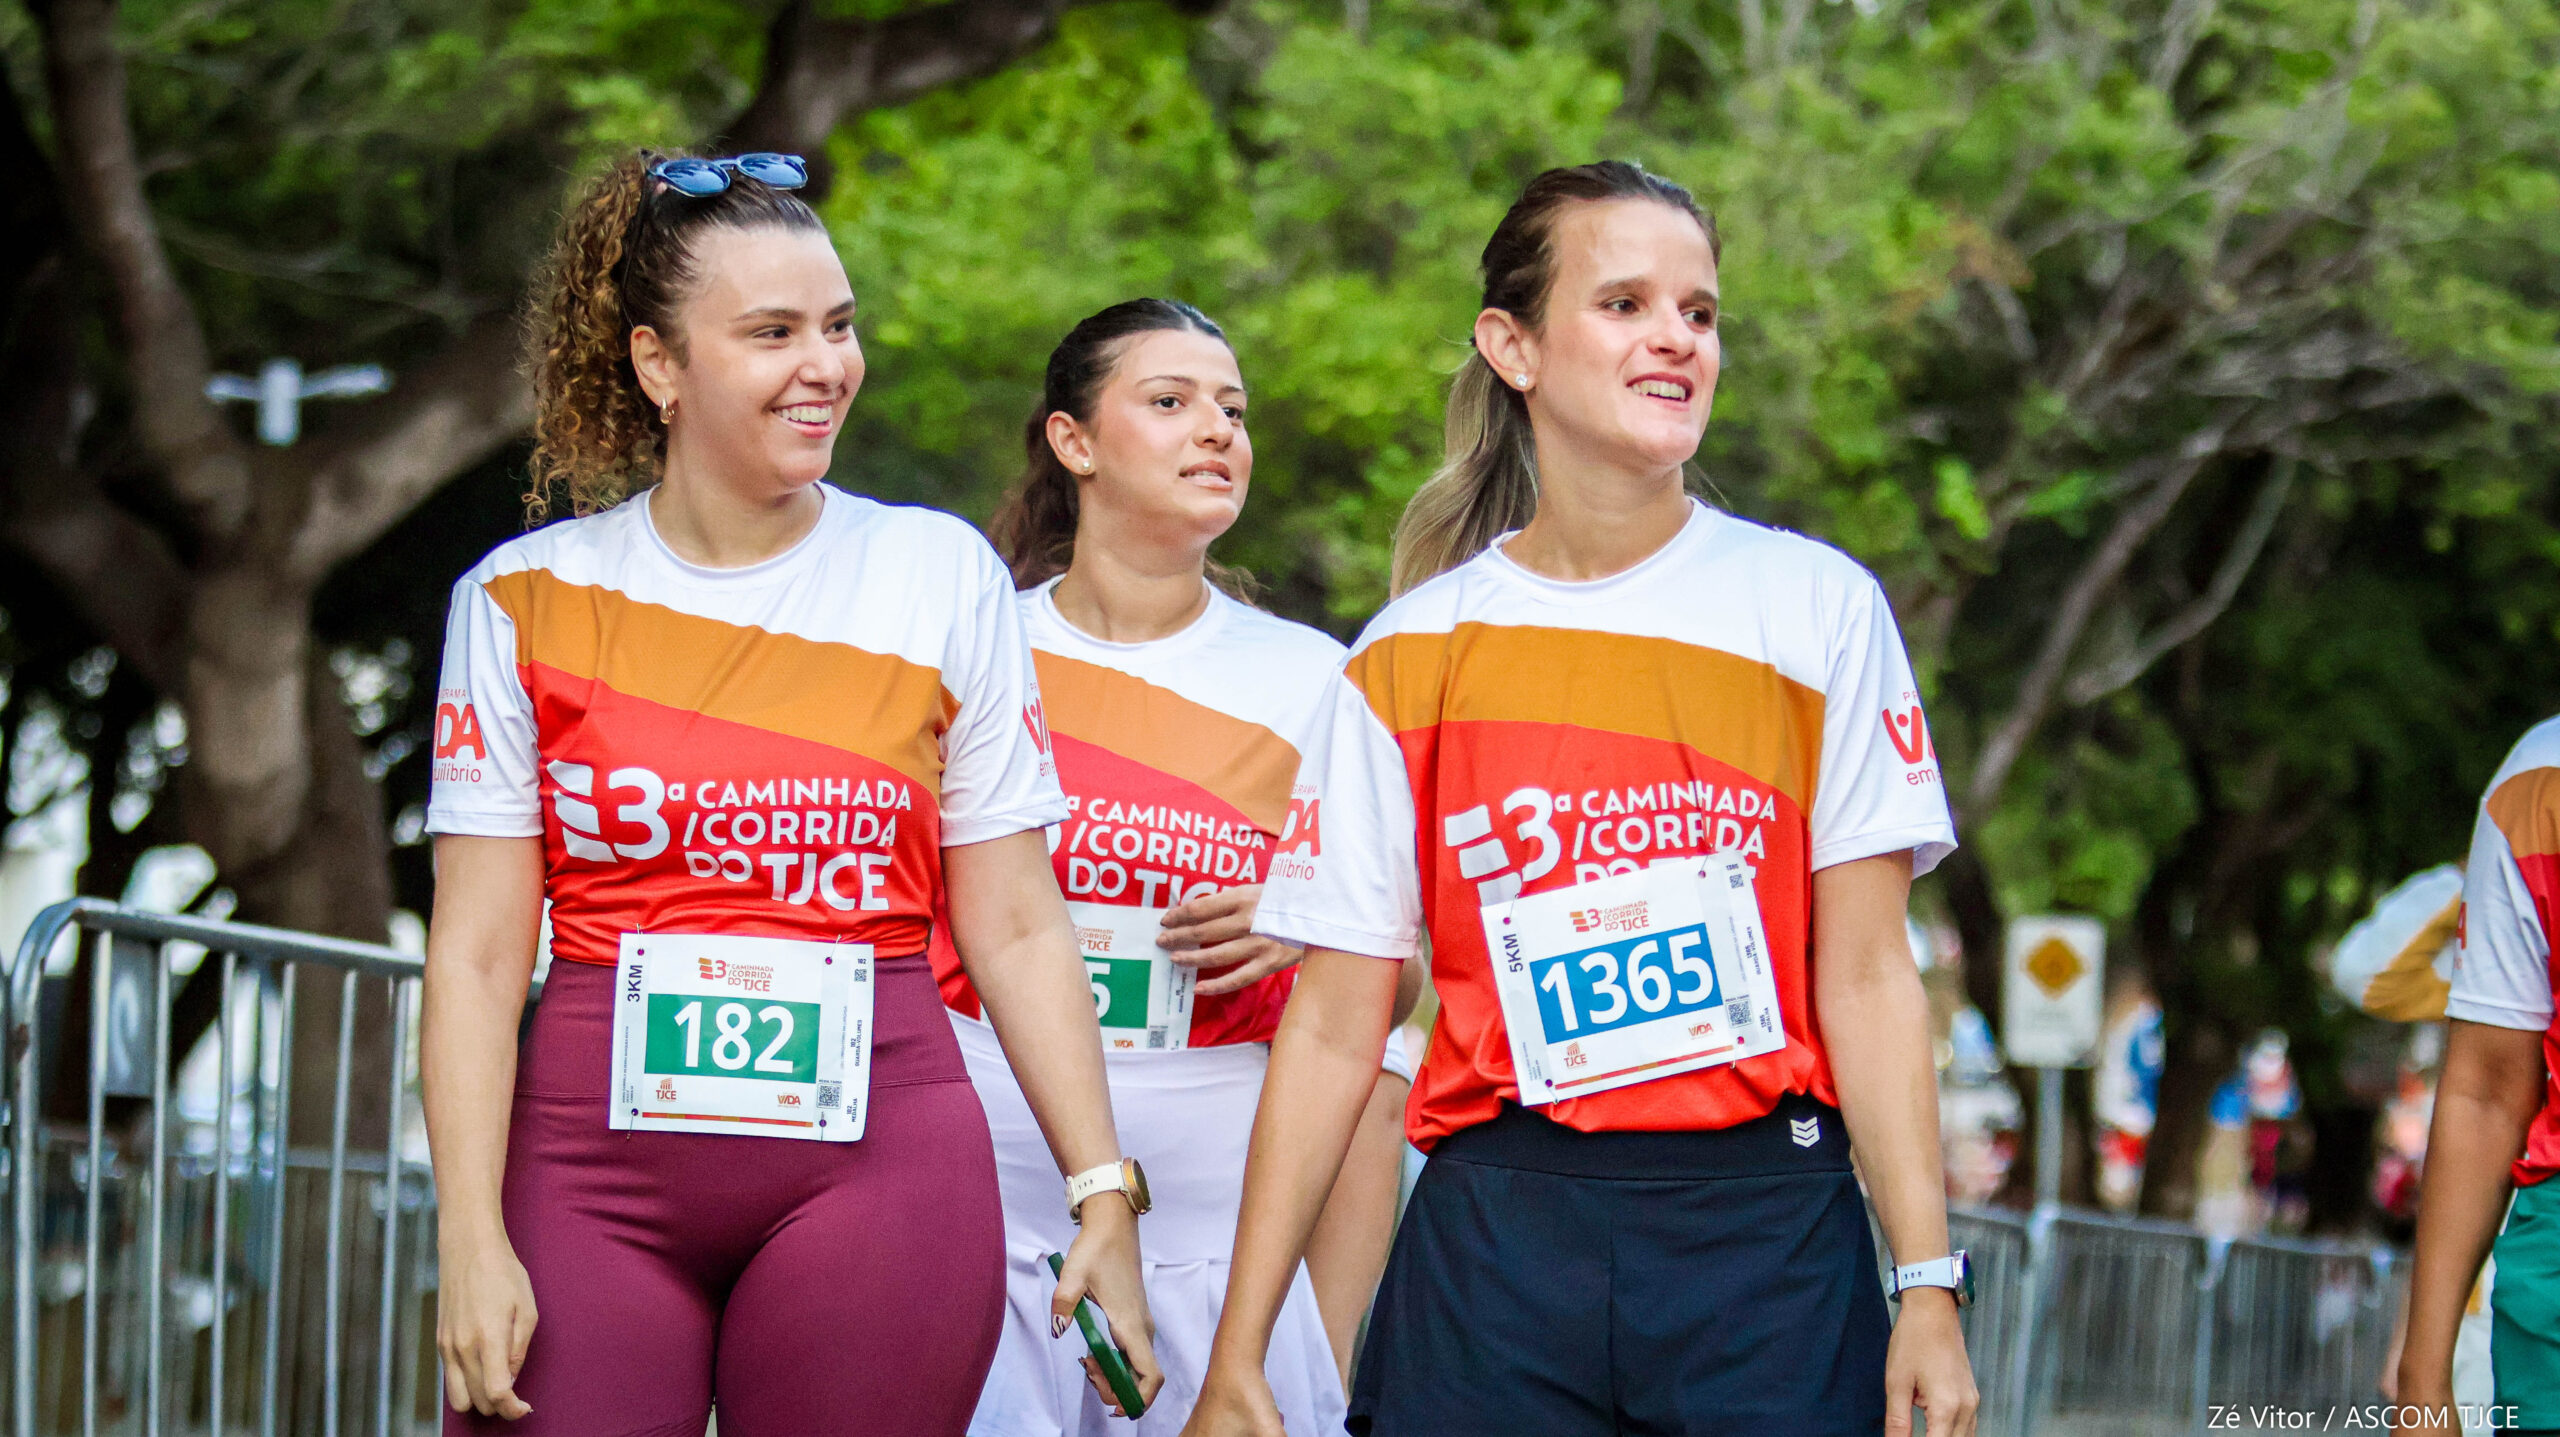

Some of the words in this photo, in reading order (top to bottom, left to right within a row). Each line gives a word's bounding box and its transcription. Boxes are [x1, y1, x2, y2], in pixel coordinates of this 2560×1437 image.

[435, 703, 486, 760] DA
[433, 762, 482, 783] uilíbrio
[696, 778, 912, 811] CAMINHADA
[1581, 780, 1776, 822] CAMINHADA
[682, 811, 897, 847] /CORRIDA
[1087, 798, 1266, 850] CAMINHADA
[1274, 798, 1321, 856] DA
[1069, 820, 1257, 883] /CORRIDA
[1269, 859, 1315, 880] uilíbrio
[684, 850, 753, 882] DO
[761, 852, 893, 911] TJCE
[1068, 856, 1128, 898] DO
[1604, 900, 1649, 914] CAMINHADA
[1604, 921, 1619, 932] DO
[1620, 915, 1650, 932] TJCE
[1087, 940, 1111, 951] TJCE
[1503, 933, 1524, 973] 5KM
[627, 965, 643, 1003] 3KM
[727, 977, 741, 986] DO
[743, 979, 770, 992] TJCE
[728, 969, 773, 980] /CORRIDA
[731, 964, 774, 973] CAMINHADA
[1540, 931, 1714, 1032] 1365
[674, 1001, 794, 1074] 182
[1564, 1053, 1588, 1068] TJCE
[655, 1089, 677, 1100] TJCE
